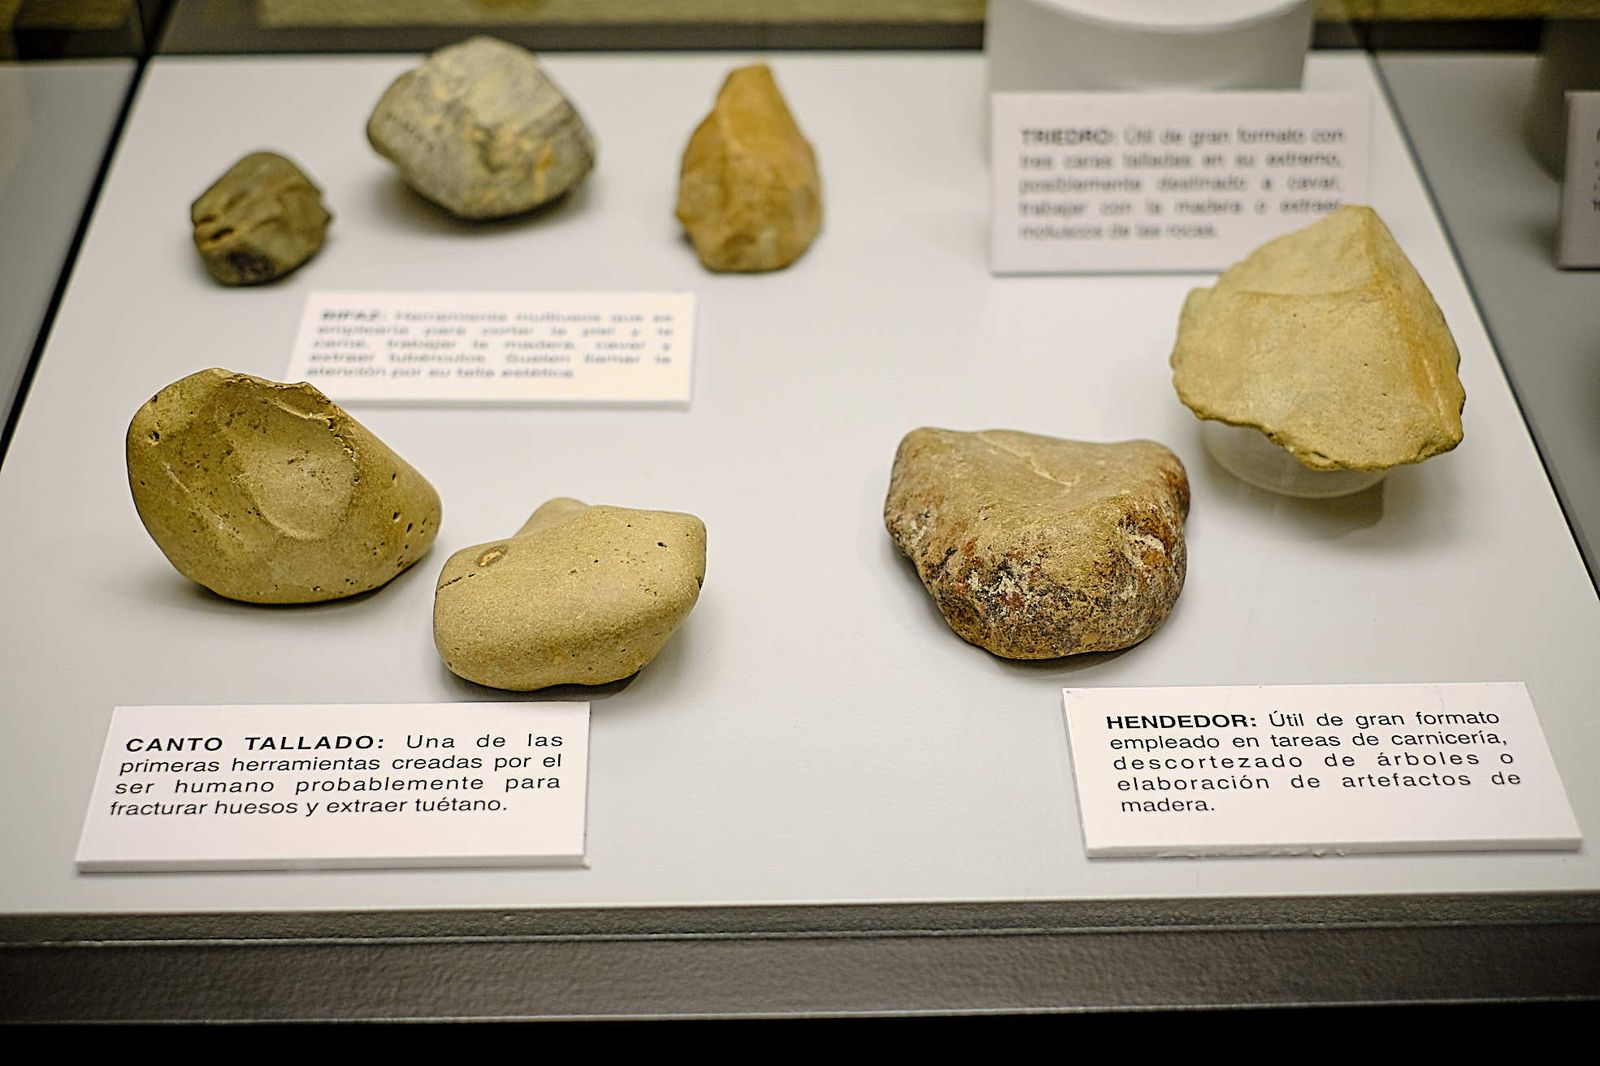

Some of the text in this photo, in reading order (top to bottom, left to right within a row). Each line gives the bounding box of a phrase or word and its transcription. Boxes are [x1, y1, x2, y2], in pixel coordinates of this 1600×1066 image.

[1106, 710, 1499, 729] HENDEDOR: Útil de gran formato
[126, 733, 563, 752] CANTO TALLADO: Una de las
[1110, 730, 1507, 752] empleado en tareas de carnicería,
[118, 753, 561, 777] primeras herramientas creadas por el
[1113, 751, 1513, 770] descortezado de árboles o
[114, 776, 560, 796] ser humano probablemente para
[1117, 771, 1520, 791] elaboración de artefactos de
[111, 796, 507, 817] fracturar huesos y extraer tuétano.
[1121, 797, 1214, 812] madera.
